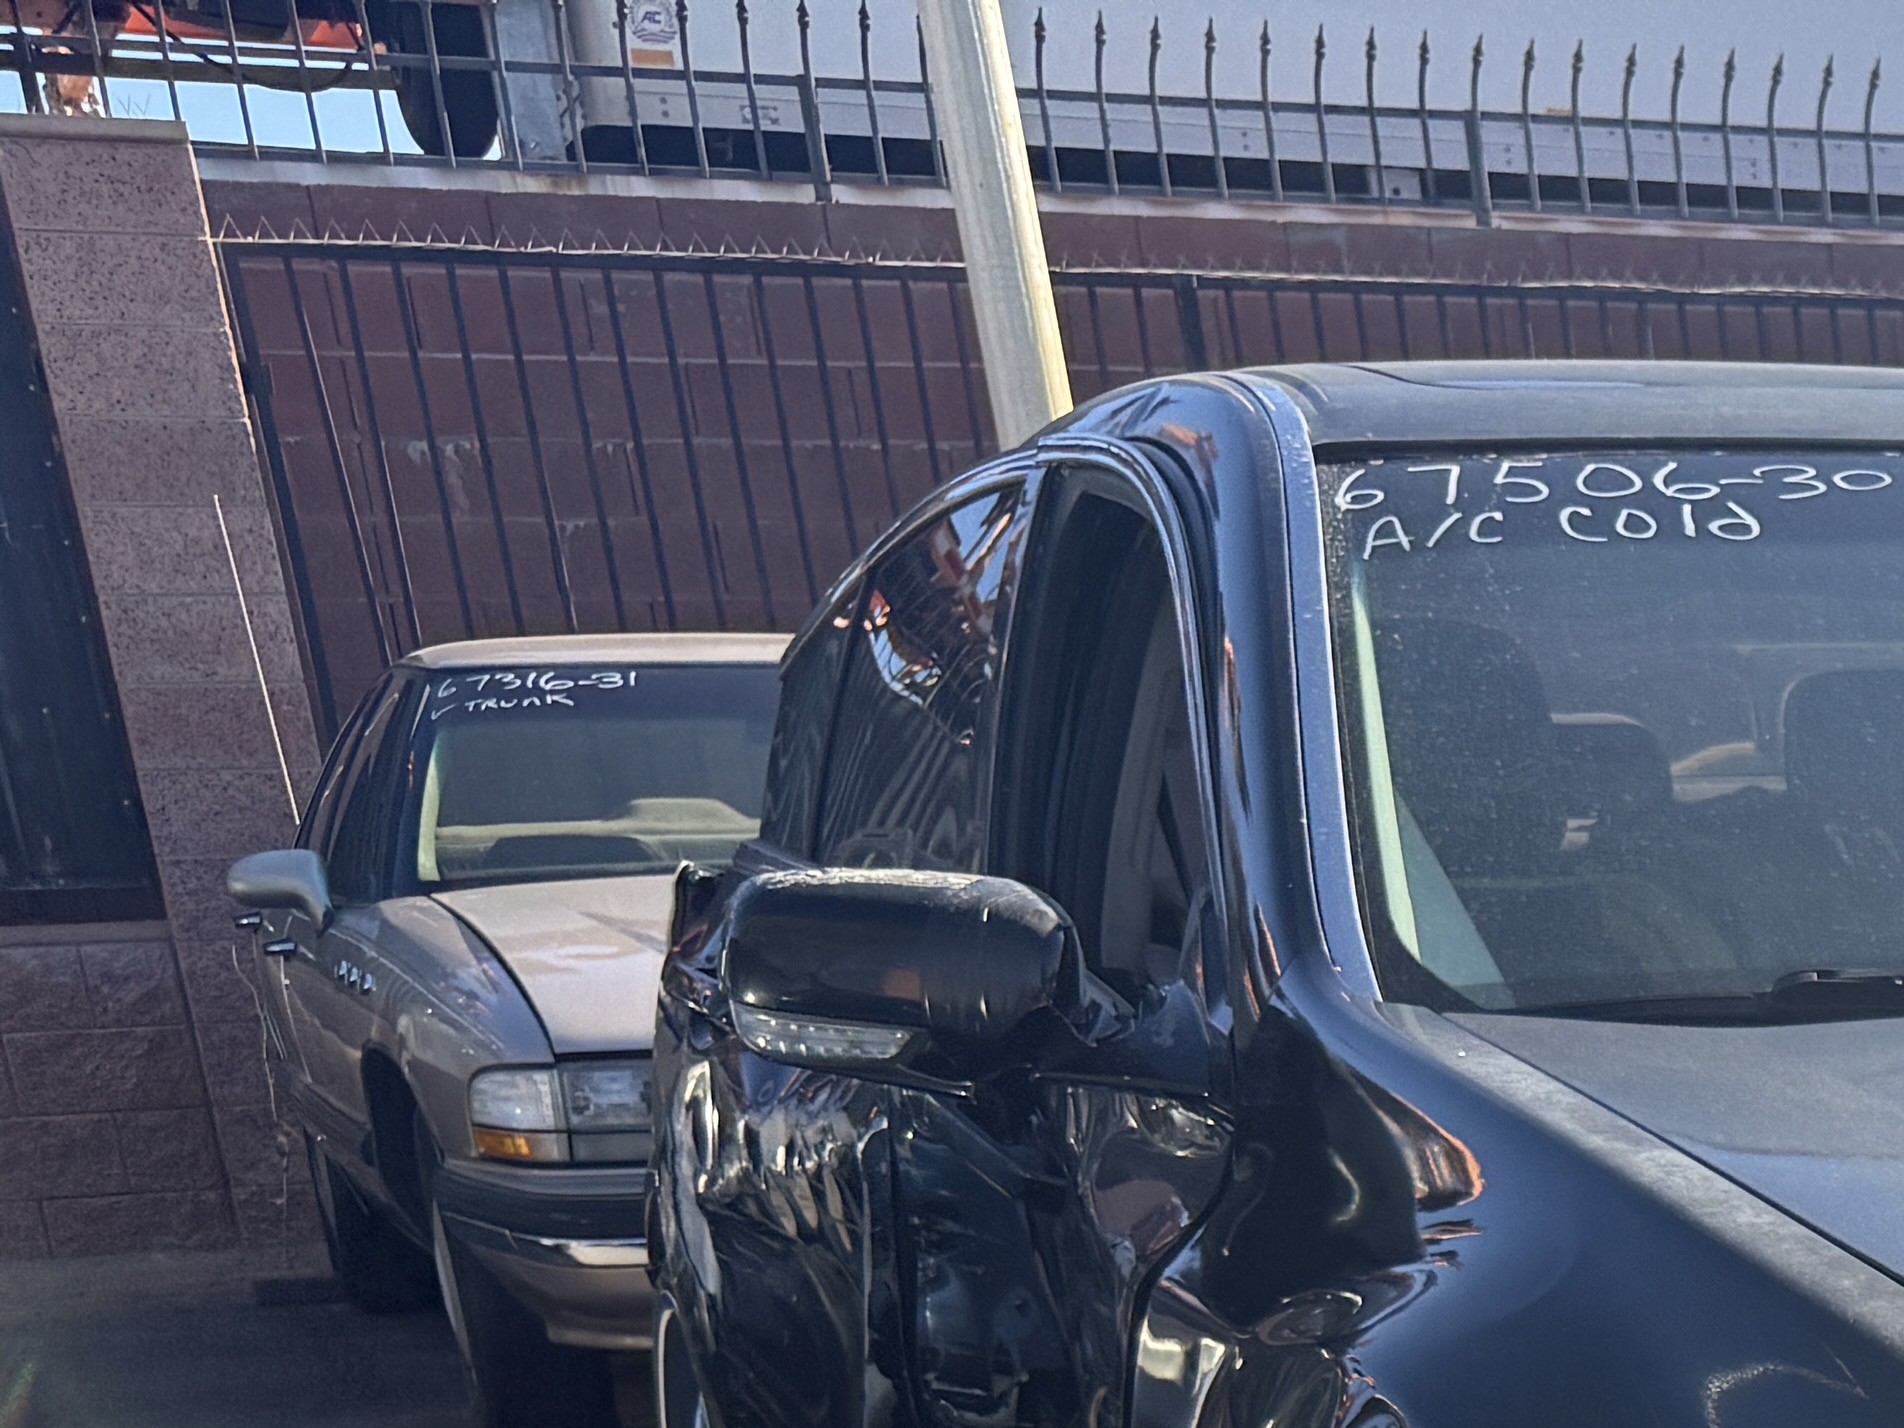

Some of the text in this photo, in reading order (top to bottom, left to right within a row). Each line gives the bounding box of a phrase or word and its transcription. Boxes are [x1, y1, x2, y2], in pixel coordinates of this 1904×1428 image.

[1335, 462, 1892, 510] 67506-30
[1362, 511, 1504, 560] A/C
[437, 671, 636, 698] 67316-31
